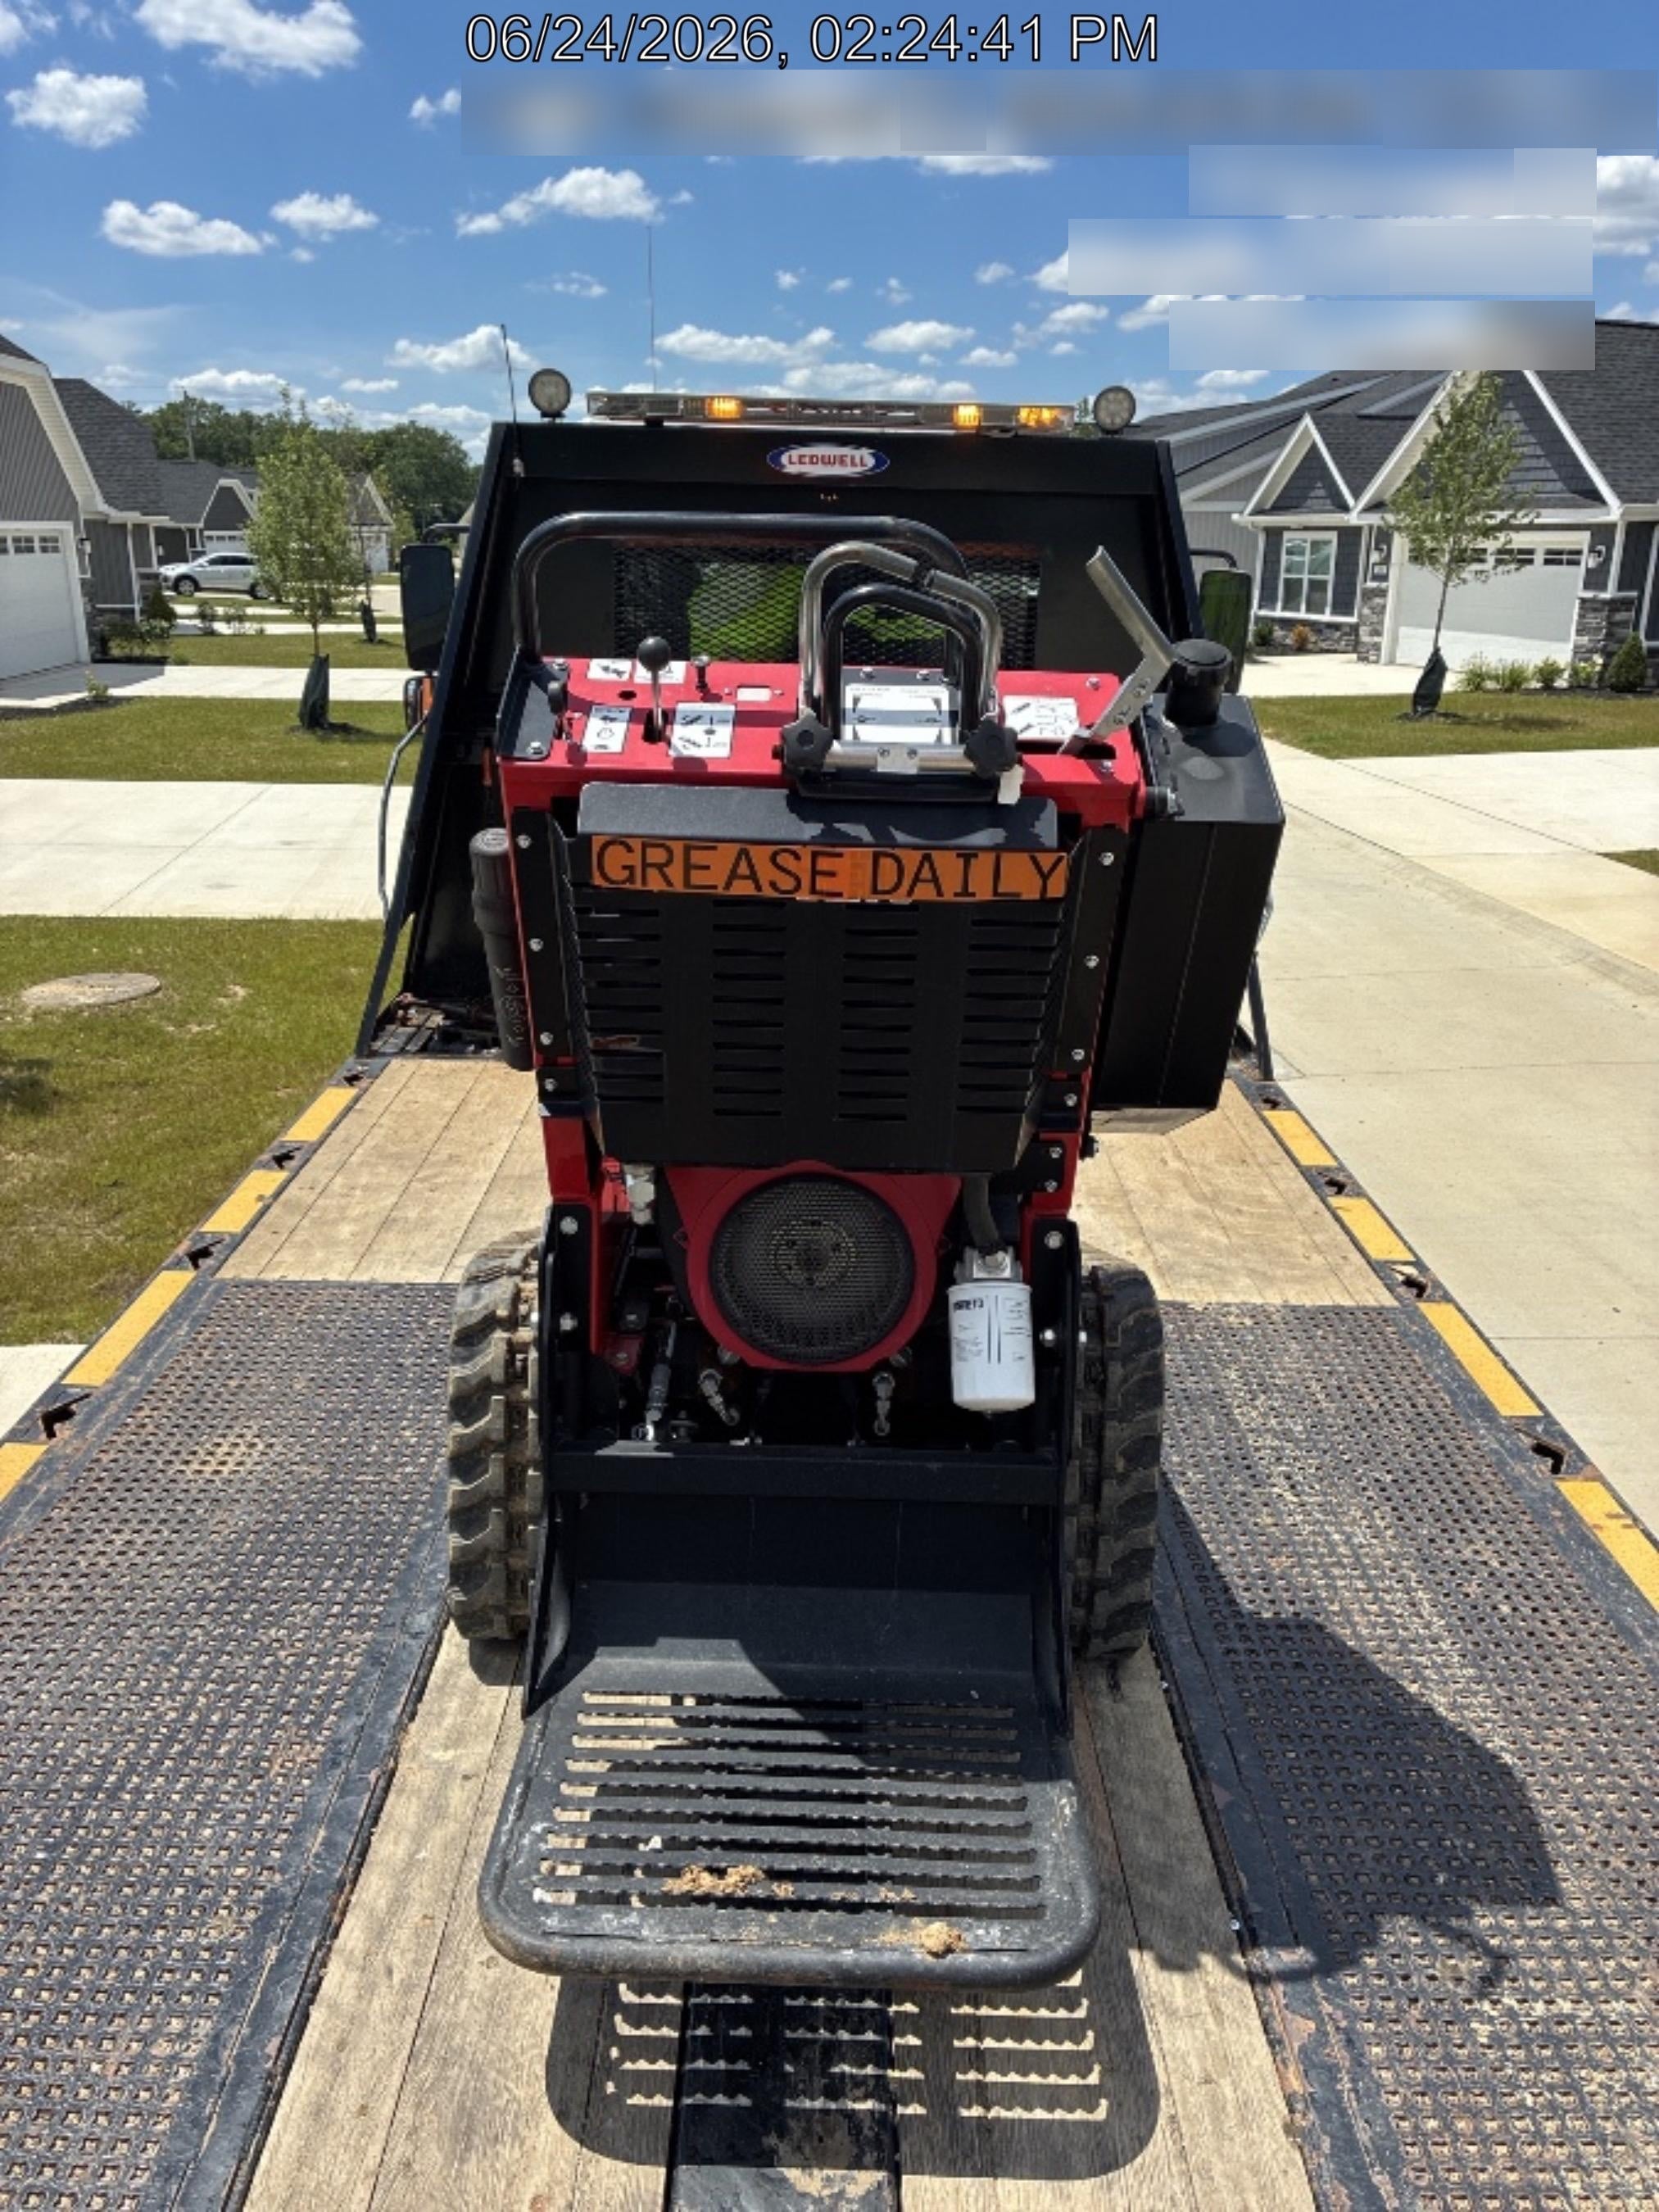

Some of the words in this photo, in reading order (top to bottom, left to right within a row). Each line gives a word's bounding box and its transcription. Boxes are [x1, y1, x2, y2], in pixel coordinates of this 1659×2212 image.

[788, 454, 868, 467] LEDWELL
[596, 840, 844, 897] GREASE
[870, 850, 1066, 899] DAILY
